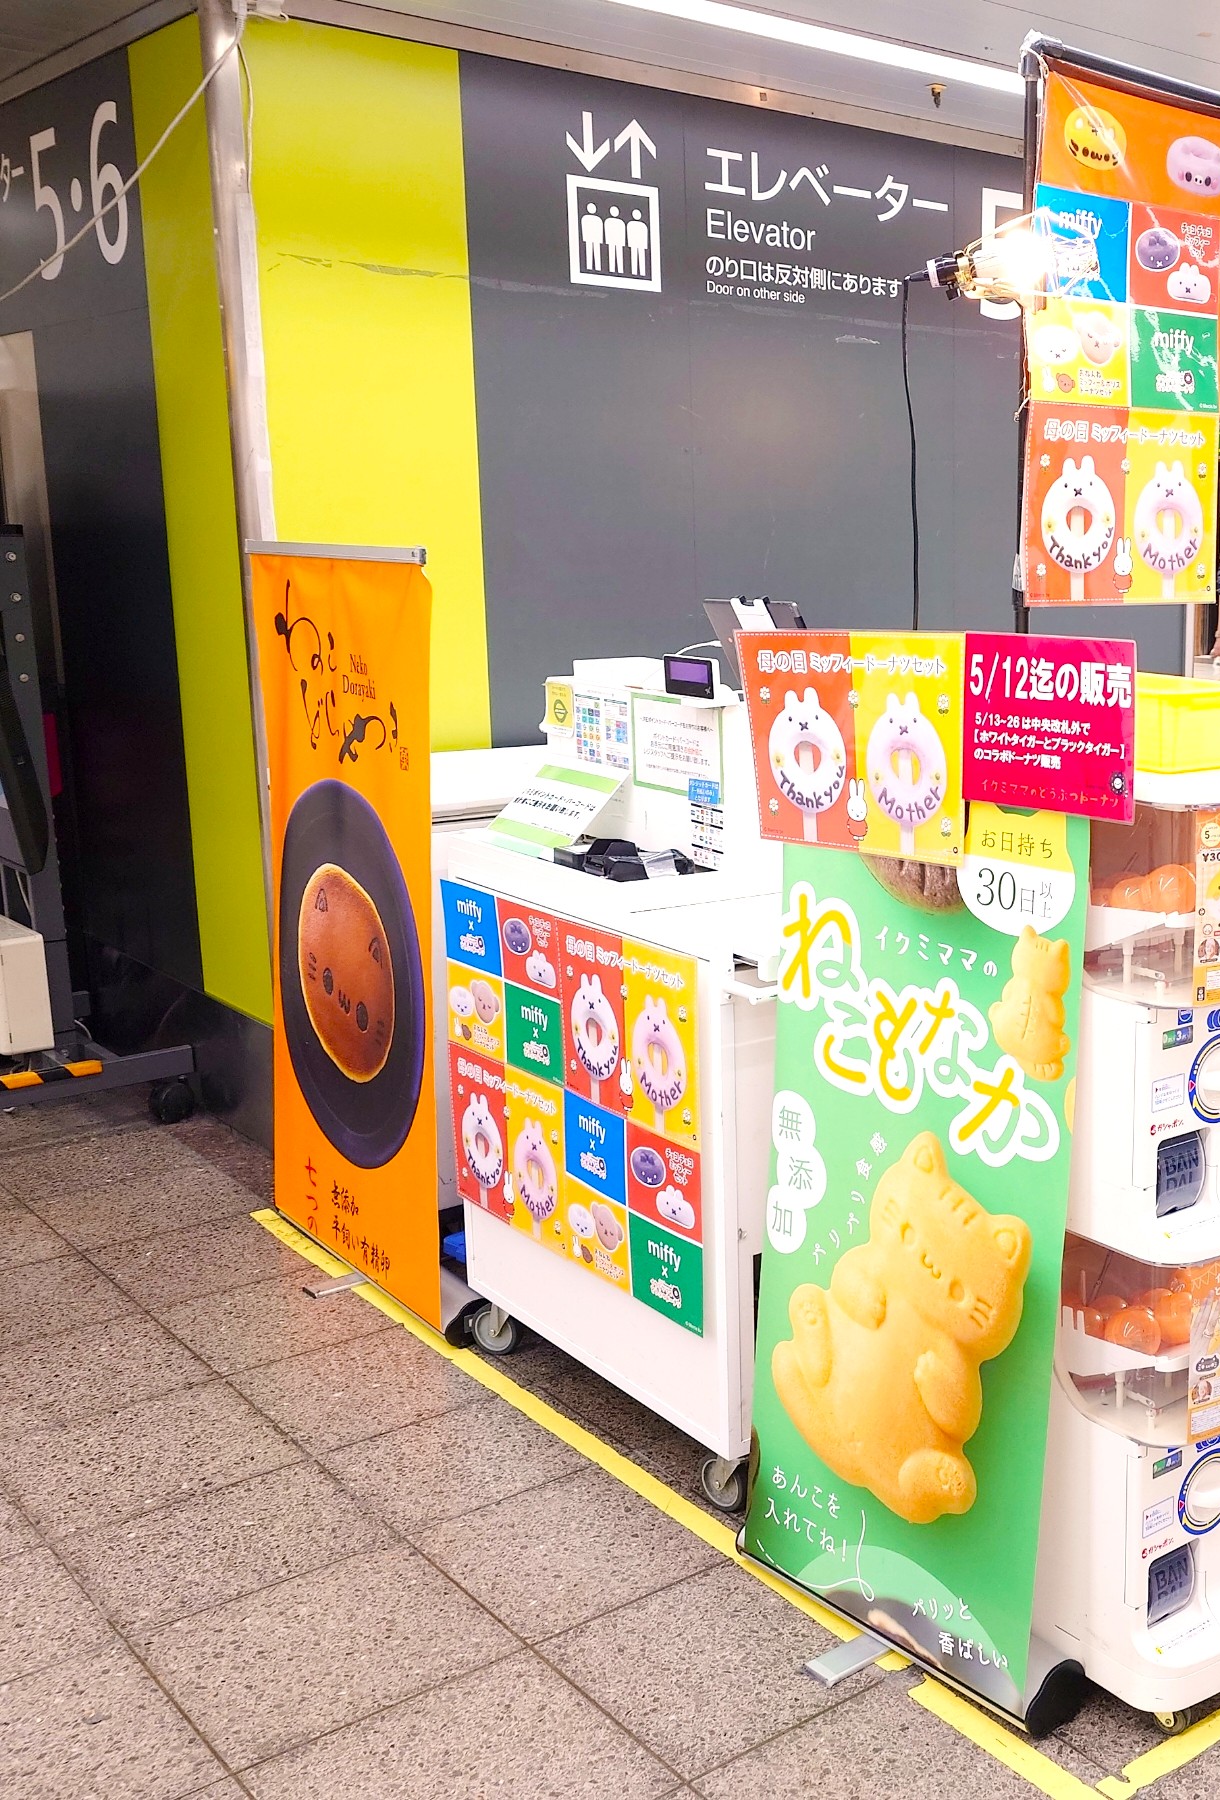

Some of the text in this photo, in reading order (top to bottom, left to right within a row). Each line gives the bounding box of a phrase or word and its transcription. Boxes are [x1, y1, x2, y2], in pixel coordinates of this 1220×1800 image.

[704, 147, 949, 223] エレベーター
[705, 207, 817, 252] Elevator
[705, 254, 902, 299] のり口は反対側にあります
[706, 280, 806, 304] Door on other side
[1153, 327, 1195, 355] miffy
[1044, 418, 1206, 449] 母の日 ミッフィードーナツセット
[1142, 537, 1199, 572] Mother
[349, 653, 368, 677] Neko
[756, 649, 946, 677] 母の日 ミッフィードーナツセット
[968, 651, 1134, 710] 5/12迄の販売
[341, 674, 377, 703] Dorayaki
[973, 747, 1062, 770] のコラボドーナツ販売
[877, 785, 942, 824] Mother
[981, 778, 1120, 808] イクミママのどうぶつドーナツ
[980, 828, 1054, 860] お日持ち
[456, 898, 483, 924] miffy
[565, 934, 685, 988] 母の日 ミッフィードーナツセット
[874, 924, 999, 979] イクミママの
[520, 1003, 549, 1032] miffy
[779, 889, 1053, 1153] ねこもなか
[456, 1056, 483, 1085] 母の日
[640, 1071, 684, 1109] Mother
[578, 1113, 607, 1146] miffy
[771, 1105, 813, 1238] 無添加
[1164, 1147, 1200, 1177] BAN
[519, 1183, 556, 1218] Mother
[647, 1237, 682, 1273] miffy
[771, 1465, 842, 1520] あんこを
[1154, 1556, 1188, 1592] BAN
[911, 1597, 973, 1620] パリッと
[938, 1630, 1009, 1670] 香ばしい
